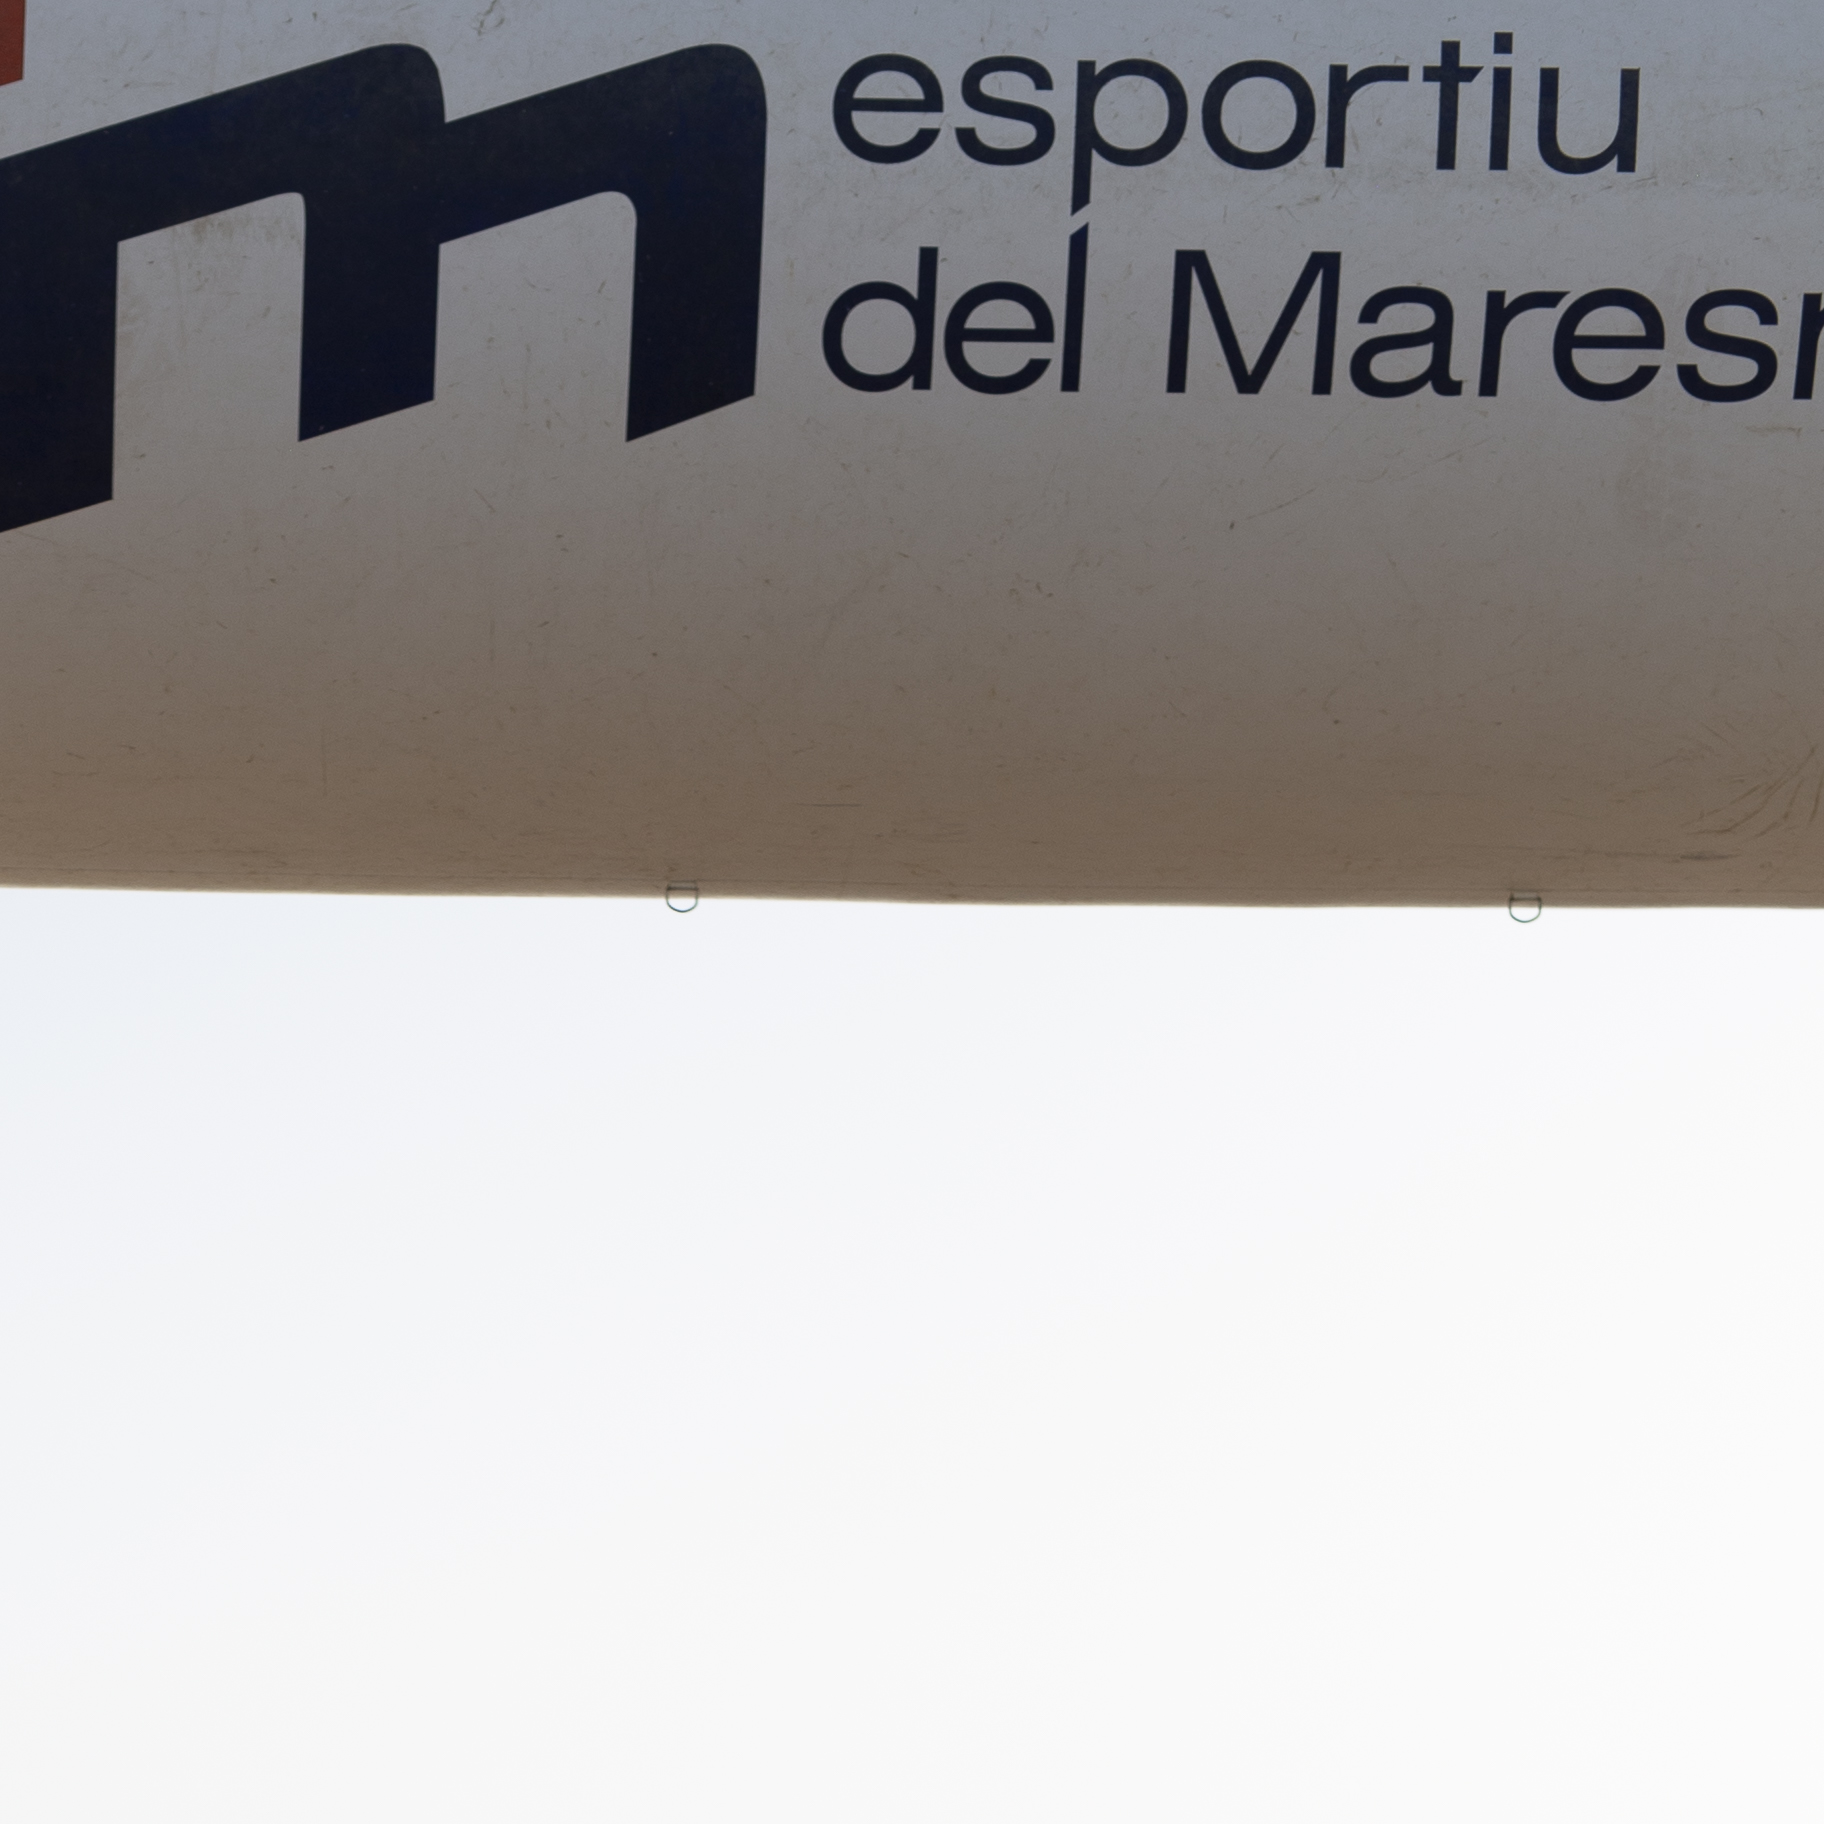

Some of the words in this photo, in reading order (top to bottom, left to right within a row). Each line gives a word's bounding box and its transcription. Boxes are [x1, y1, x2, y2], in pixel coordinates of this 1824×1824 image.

[834, 33, 1641, 216] esportiu
[822, 220, 1090, 395] del
[1166, 249, 1824, 403] Mares
